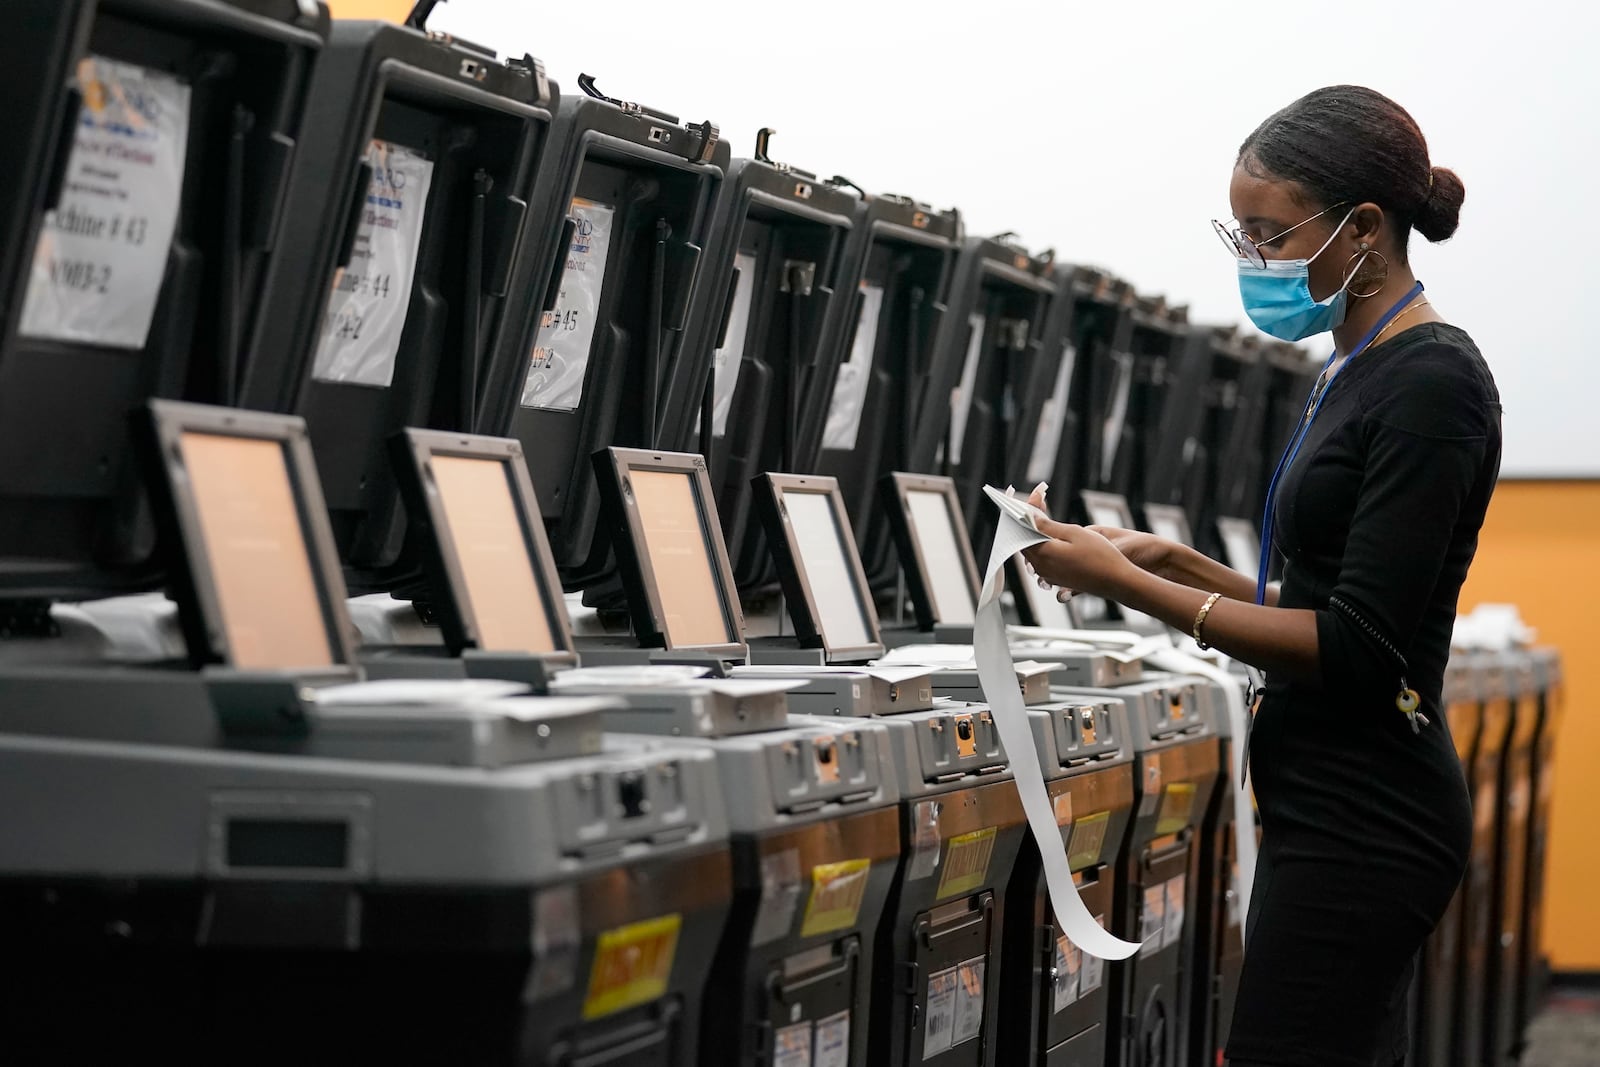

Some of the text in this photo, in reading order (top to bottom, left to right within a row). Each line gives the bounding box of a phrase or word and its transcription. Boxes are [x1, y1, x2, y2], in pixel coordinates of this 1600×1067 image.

[126, 216, 148, 246] 43
[373, 274, 390, 298] 44
[552, 309, 562, 329] #
[562, 310, 578, 331] 45
